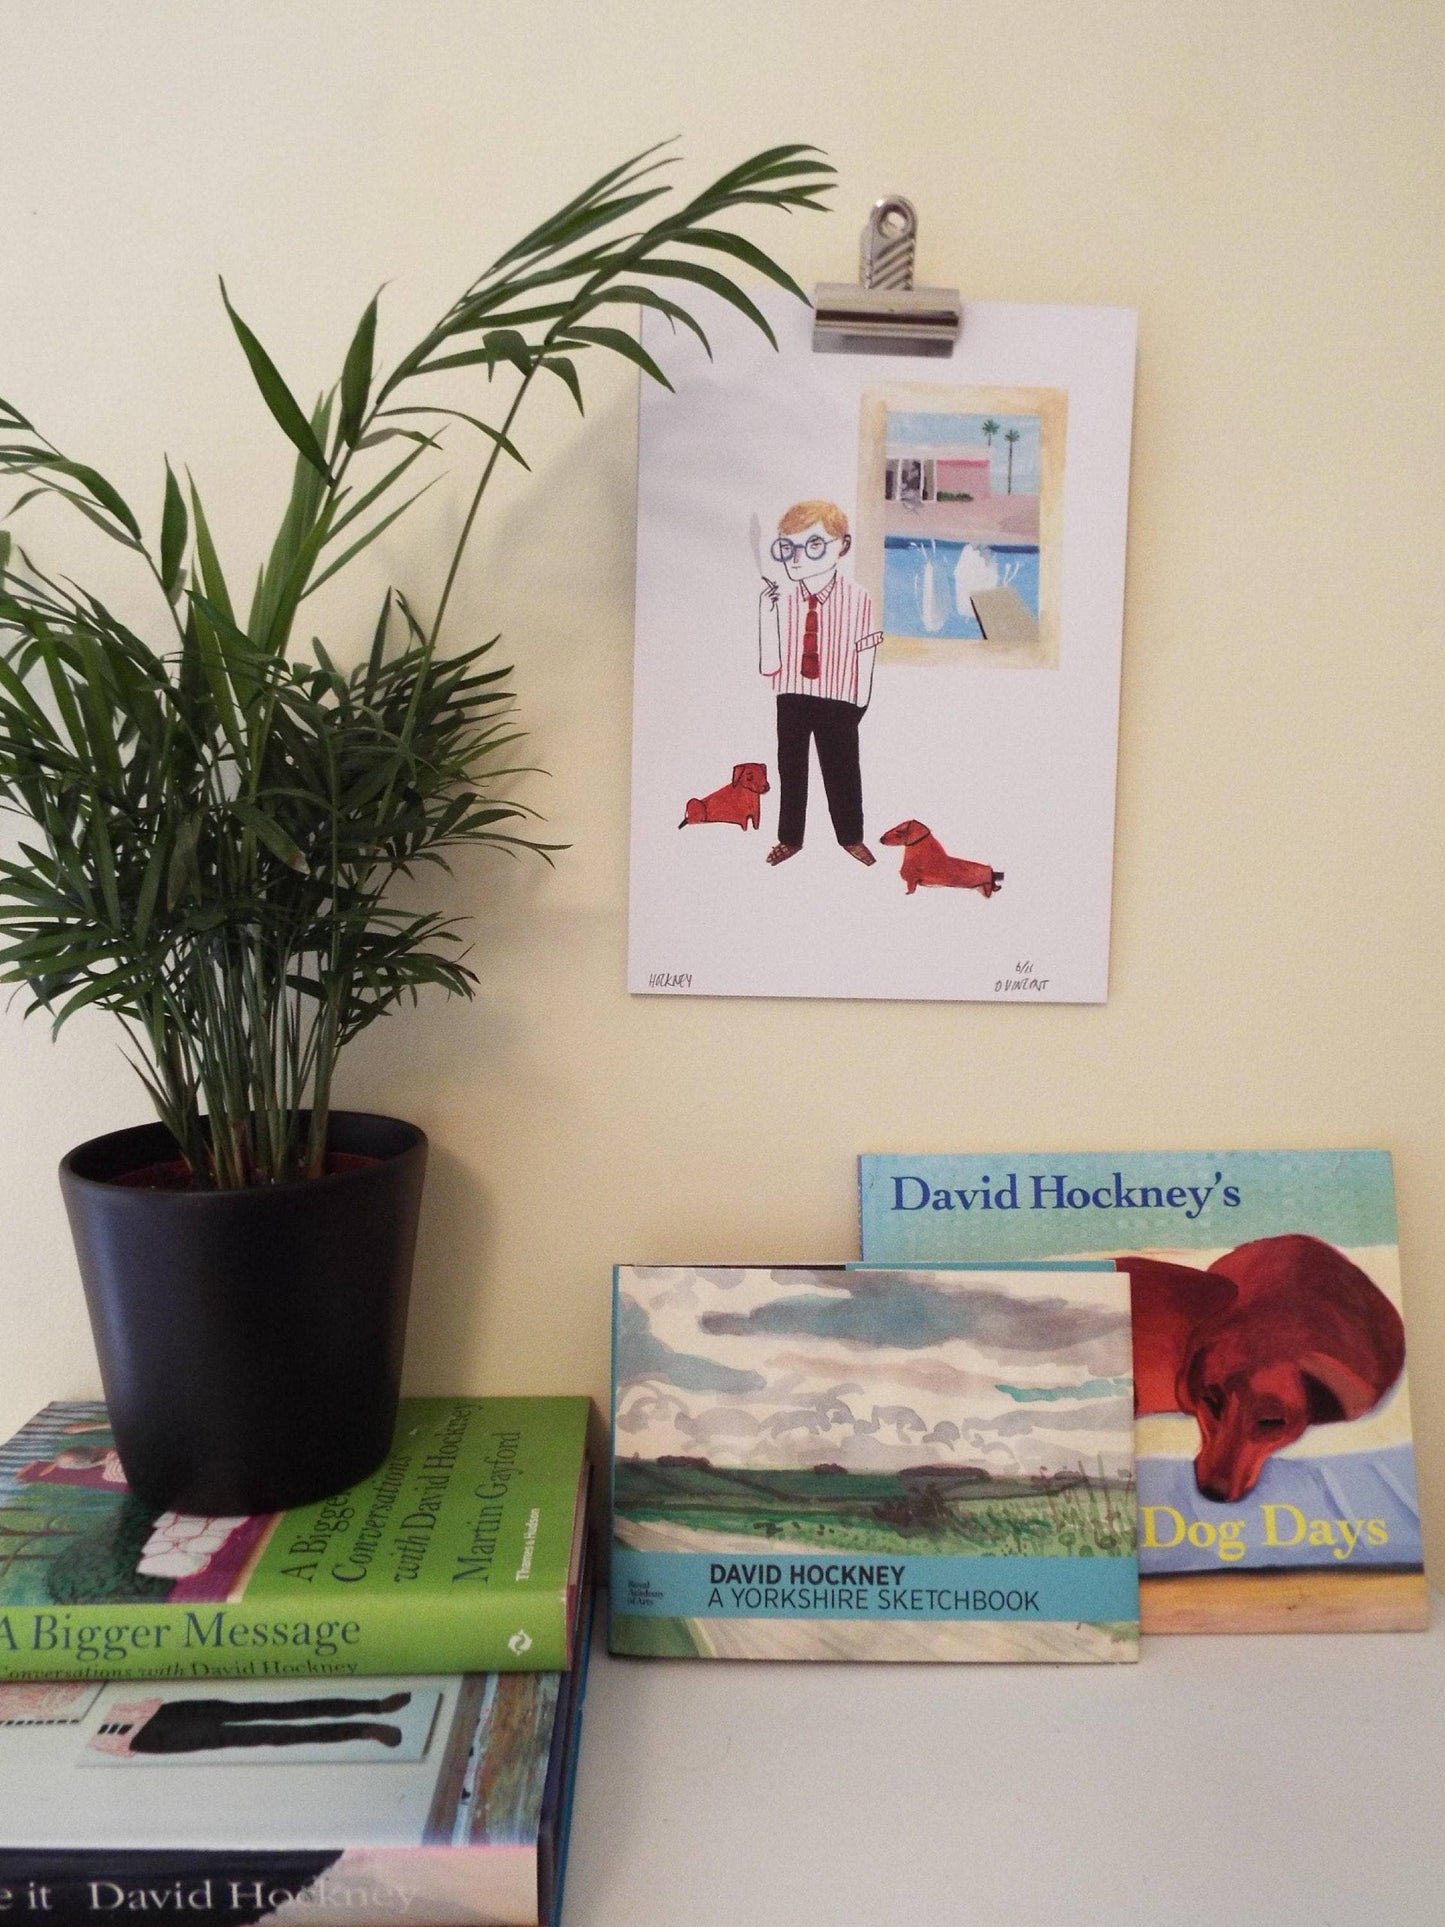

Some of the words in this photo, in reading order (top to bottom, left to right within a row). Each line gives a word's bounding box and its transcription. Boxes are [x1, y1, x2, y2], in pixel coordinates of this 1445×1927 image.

[890, 1172, 1021, 1211] David
[1029, 1171, 1241, 1219] Hockney's
[422, 1402, 483, 1469] Hockney
[474, 1431, 525, 1500] Gayford
[289, 1492, 356, 1554] Bigge
[331, 1453, 413, 1582] Conversations
[399, 1473, 451, 1530] David
[452, 1504, 504, 1584] Martin
[1138, 1505, 1247, 1562] Dog
[1260, 1503, 1389, 1560] Days
[280, 1561, 319, 1583] A
[391, 1535, 431, 1583] with
[710, 1564, 782, 1585] DAVID
[790, 1565, 906, 1586] HOCKNEY
[708, 1588, 724, 1608] A
[731, 1588, 869, 1610] YORKSHIRE
[878, 1589, 1040, 1611] SKETCHBOOK
[0, 1615, 18, 1651] A
[32, 1613, 171, 1661] Bigger
[183, 1611, 361, 1656] Message
[4, 1665, 131, 1680] onversations
[191, 1661, 255, 1676] David
[263, 1659, 358, 1675] Hockney
[28, 1881, 53, 1911] it
[86, 1880, 213, 1911] David
